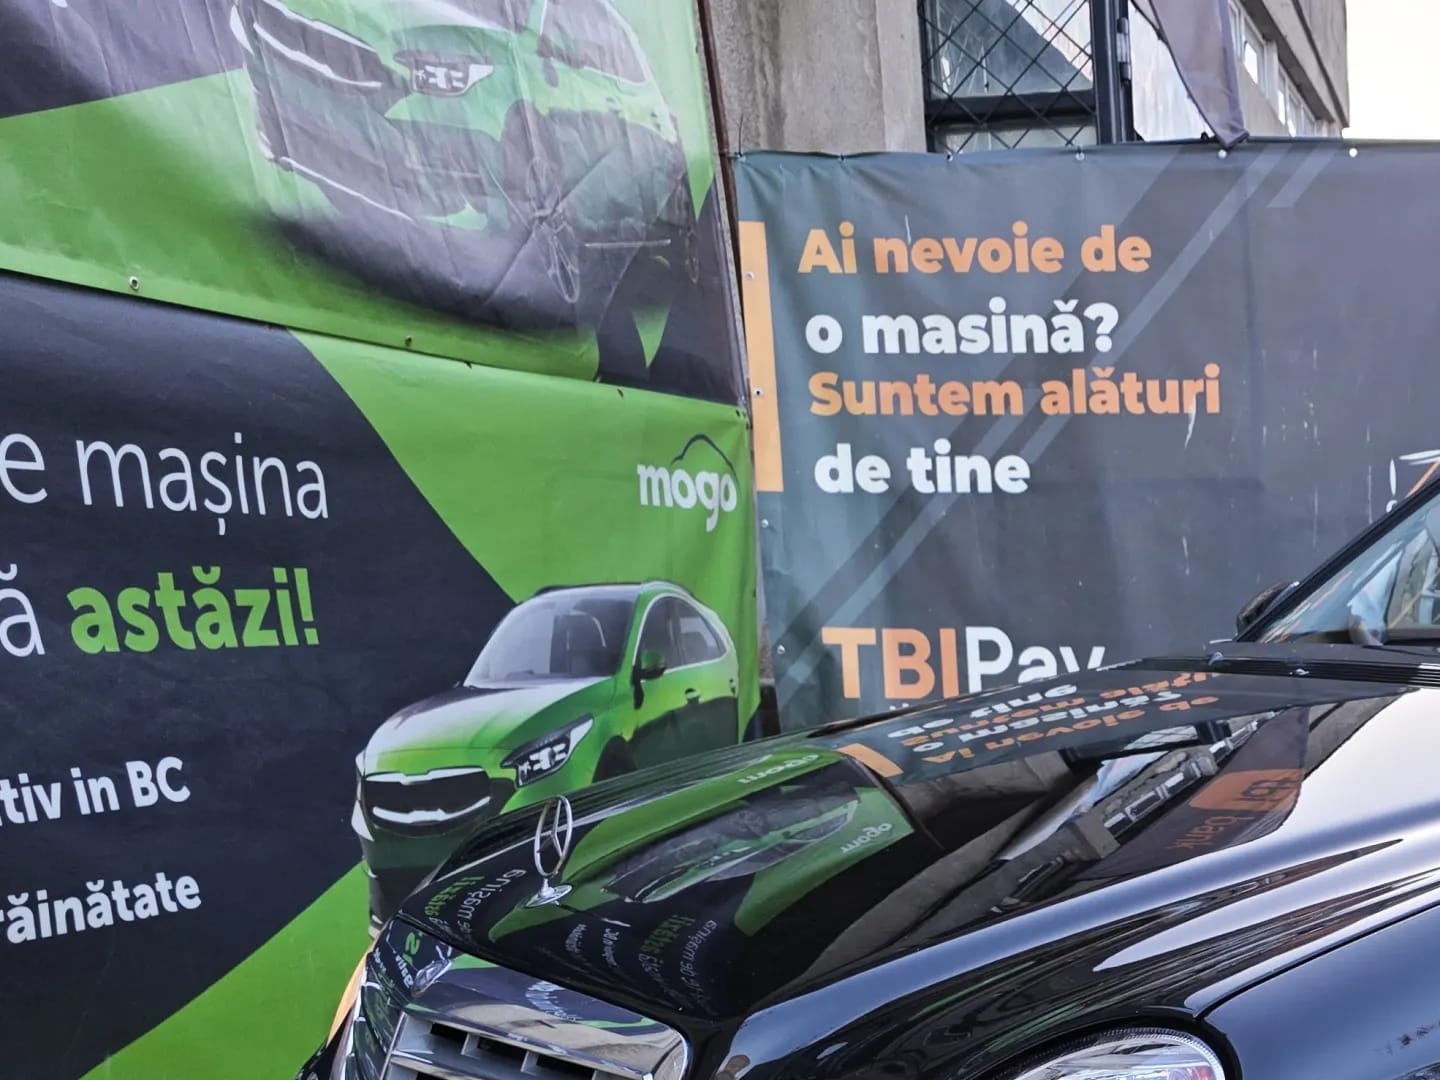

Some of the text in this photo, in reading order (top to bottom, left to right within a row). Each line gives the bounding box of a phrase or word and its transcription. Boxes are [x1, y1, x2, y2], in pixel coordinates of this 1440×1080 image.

[797, 221, 1152, 275] Ai nevoie de
[804, 296, 1119, 355] o masină?
[808, 363, 1221, 417] Suntem alături
[76, 432, 328, 535] mașina
[636, 463, 738, 532] mogo
[814, 438, 1031, 494] de tine
[66, 566, 319, 654] astăzi!
[0, 756, 191, 827] tiv in BC
